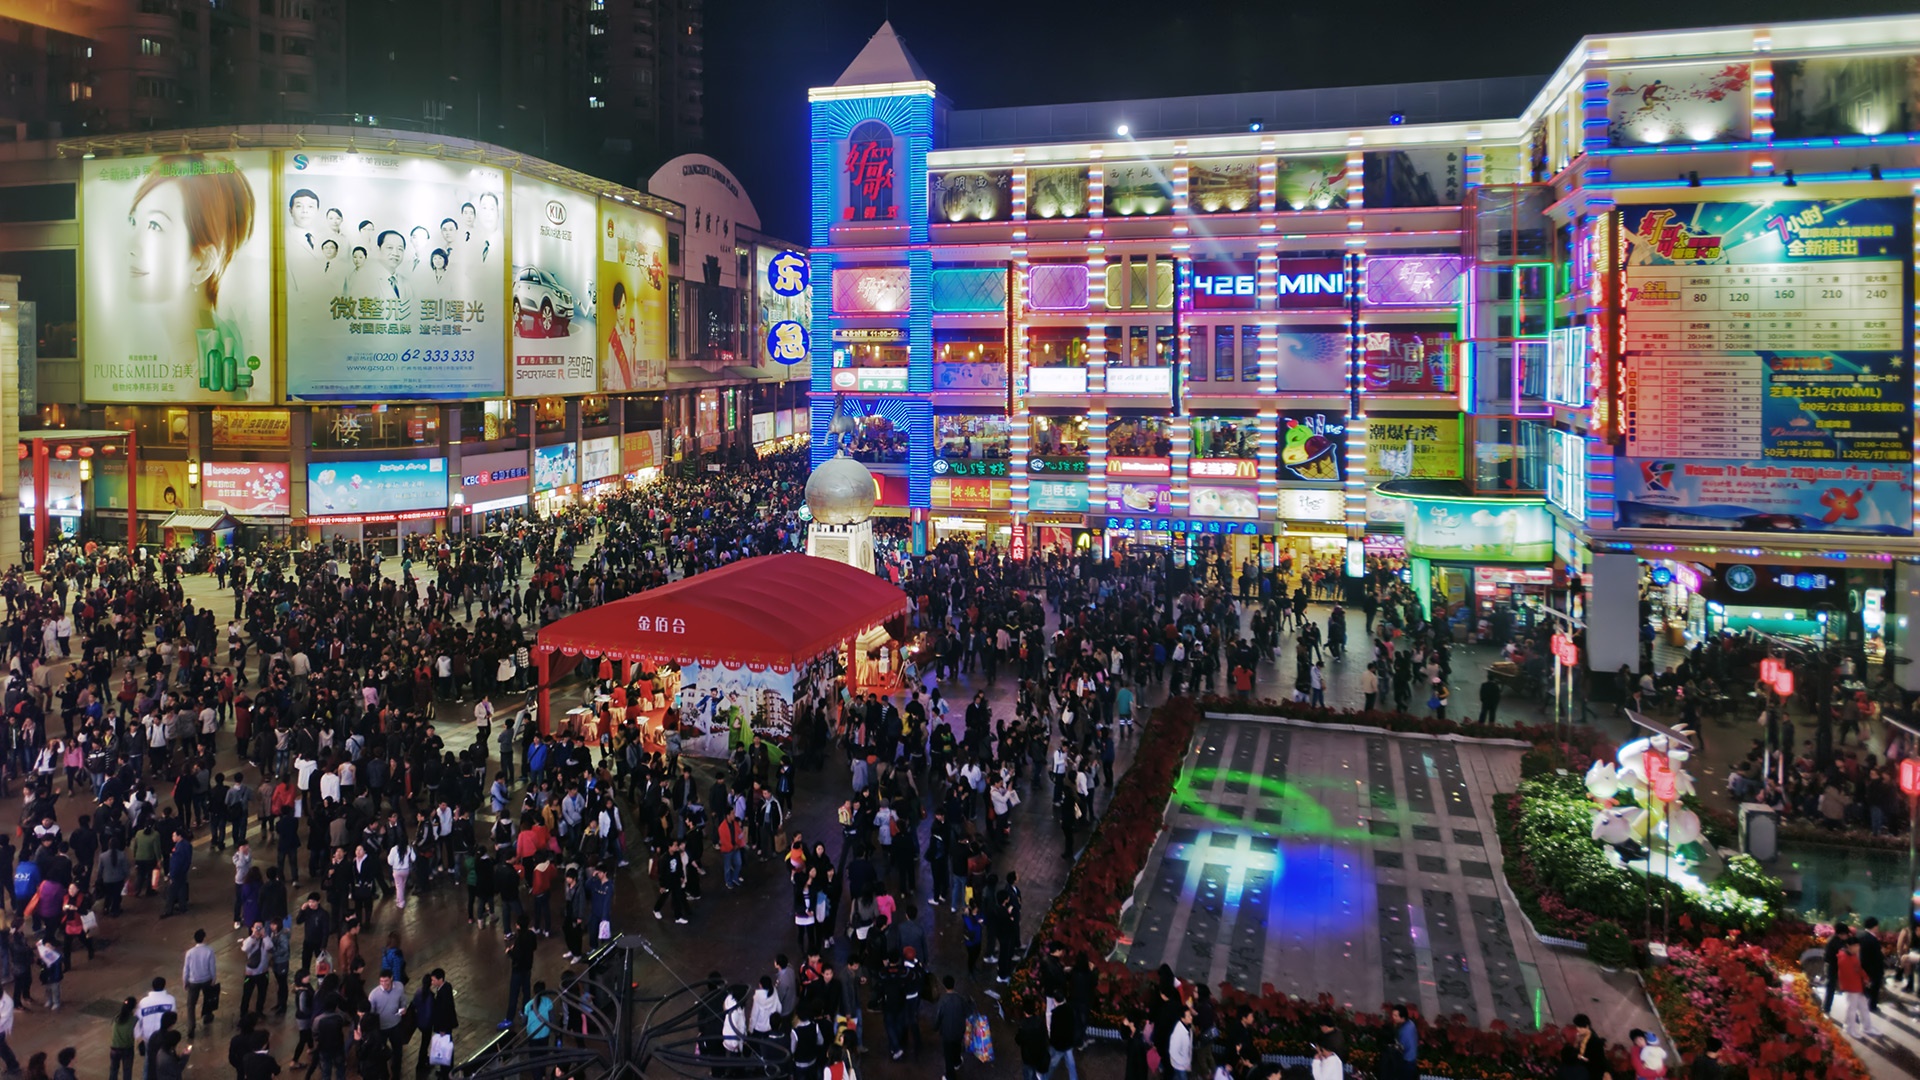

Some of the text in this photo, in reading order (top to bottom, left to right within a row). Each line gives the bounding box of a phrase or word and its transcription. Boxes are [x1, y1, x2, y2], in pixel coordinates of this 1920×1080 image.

[871, 147, 894, 158] KTV
[549, 205, 563, 220] KIA
[1788, 239, 1859, 256] 全新推出
[1194, 273, 1344, 296] 426 MINI
[1693, 293, 1707, 302] 80
[1729, 293, 1750, 302] 120
[1774, 289, 1795, 299] 160
[1821, 289, 1843, 299] 210
[1866, 289, 1888, 299] 240
[330, 296, 485, 323] 微整形 到曙光
[349, 322, 412, 335] 树国际品牌
[373, 353, 398, 362] (020)
[401, 349, 421, 362] 62
[423, 350, 449, 362] 333
[452, 350, 475, 362] 333
[93, 364, 194, 378] PURE&MILD 泊美
[516, 368, 565, 379] SPORTAGE R
[567, 356, 594, 378] 智跑
[1684, 463, 1902, 481] Welcome To GuangZhou 2010 Asian Para Games
[463, 475, 480, 486] ICBC
[1041, 484, 1077, 497] 屈臣氏
